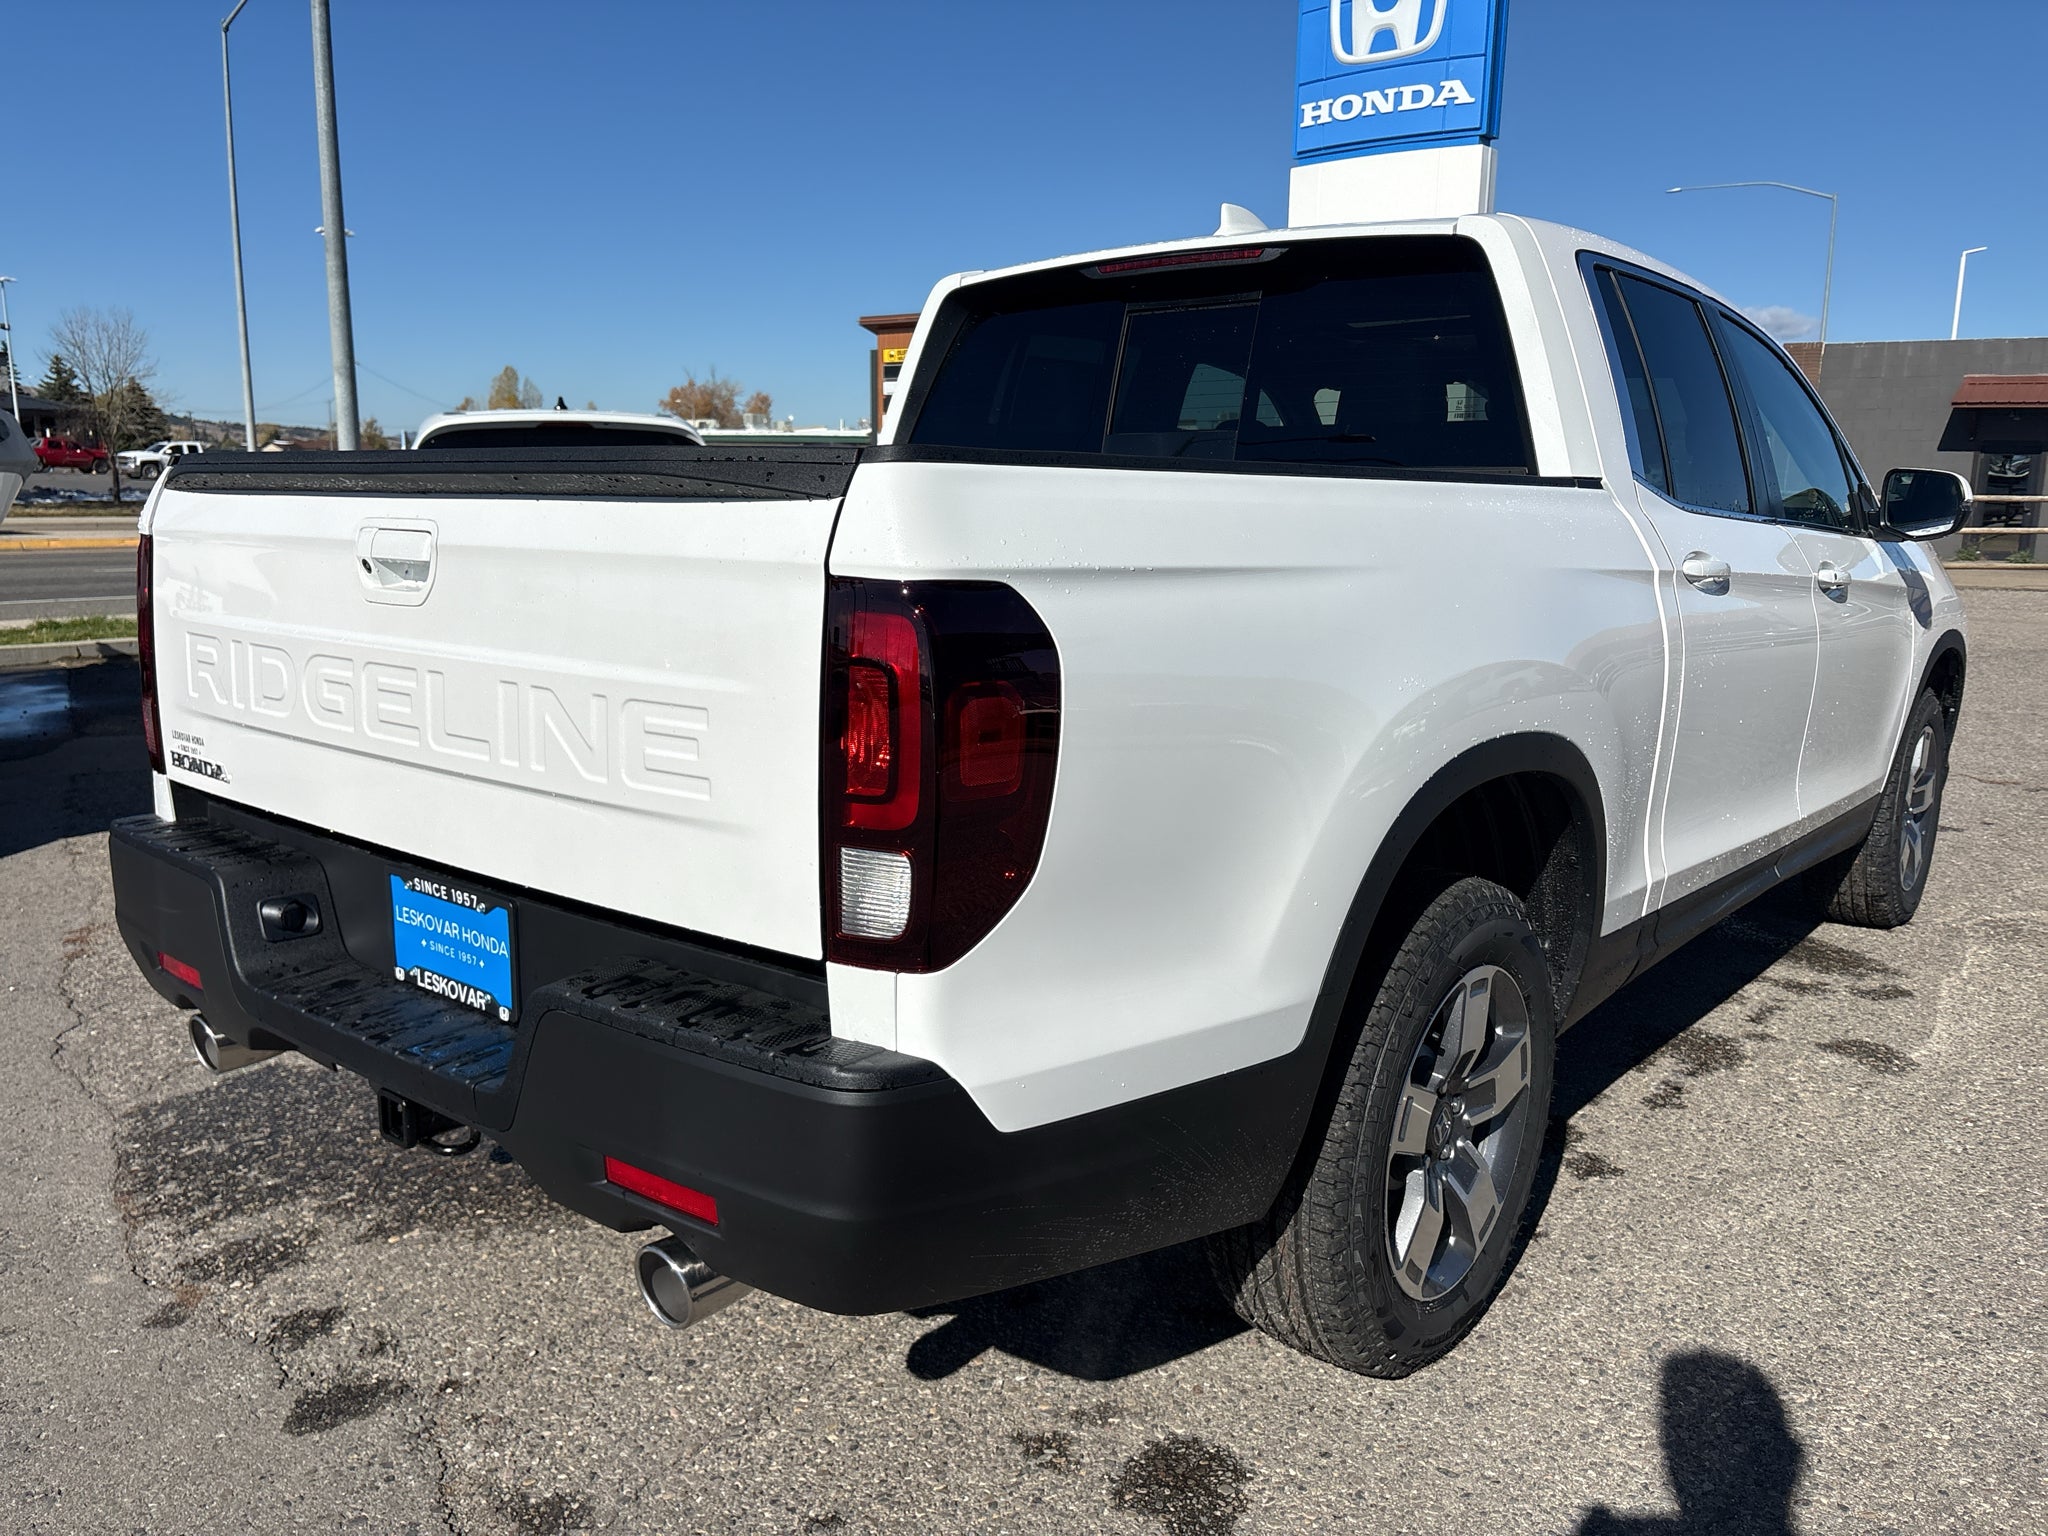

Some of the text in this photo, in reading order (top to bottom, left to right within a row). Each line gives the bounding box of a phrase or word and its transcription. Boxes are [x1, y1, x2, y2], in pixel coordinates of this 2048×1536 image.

[1299, 79, 1475, 128] HONDA
[186, 631, 712, 800] RIDGELINE
[170, 750, 230, 784] HONDA
[413, 877, 478, 908] SINCE 1957
[395, 904, 509, 958] LESKOVAR HONDA
[429, 940, 477, 966] SINCE 1957
[416, 968, 486, 1011] LESKOVAR
